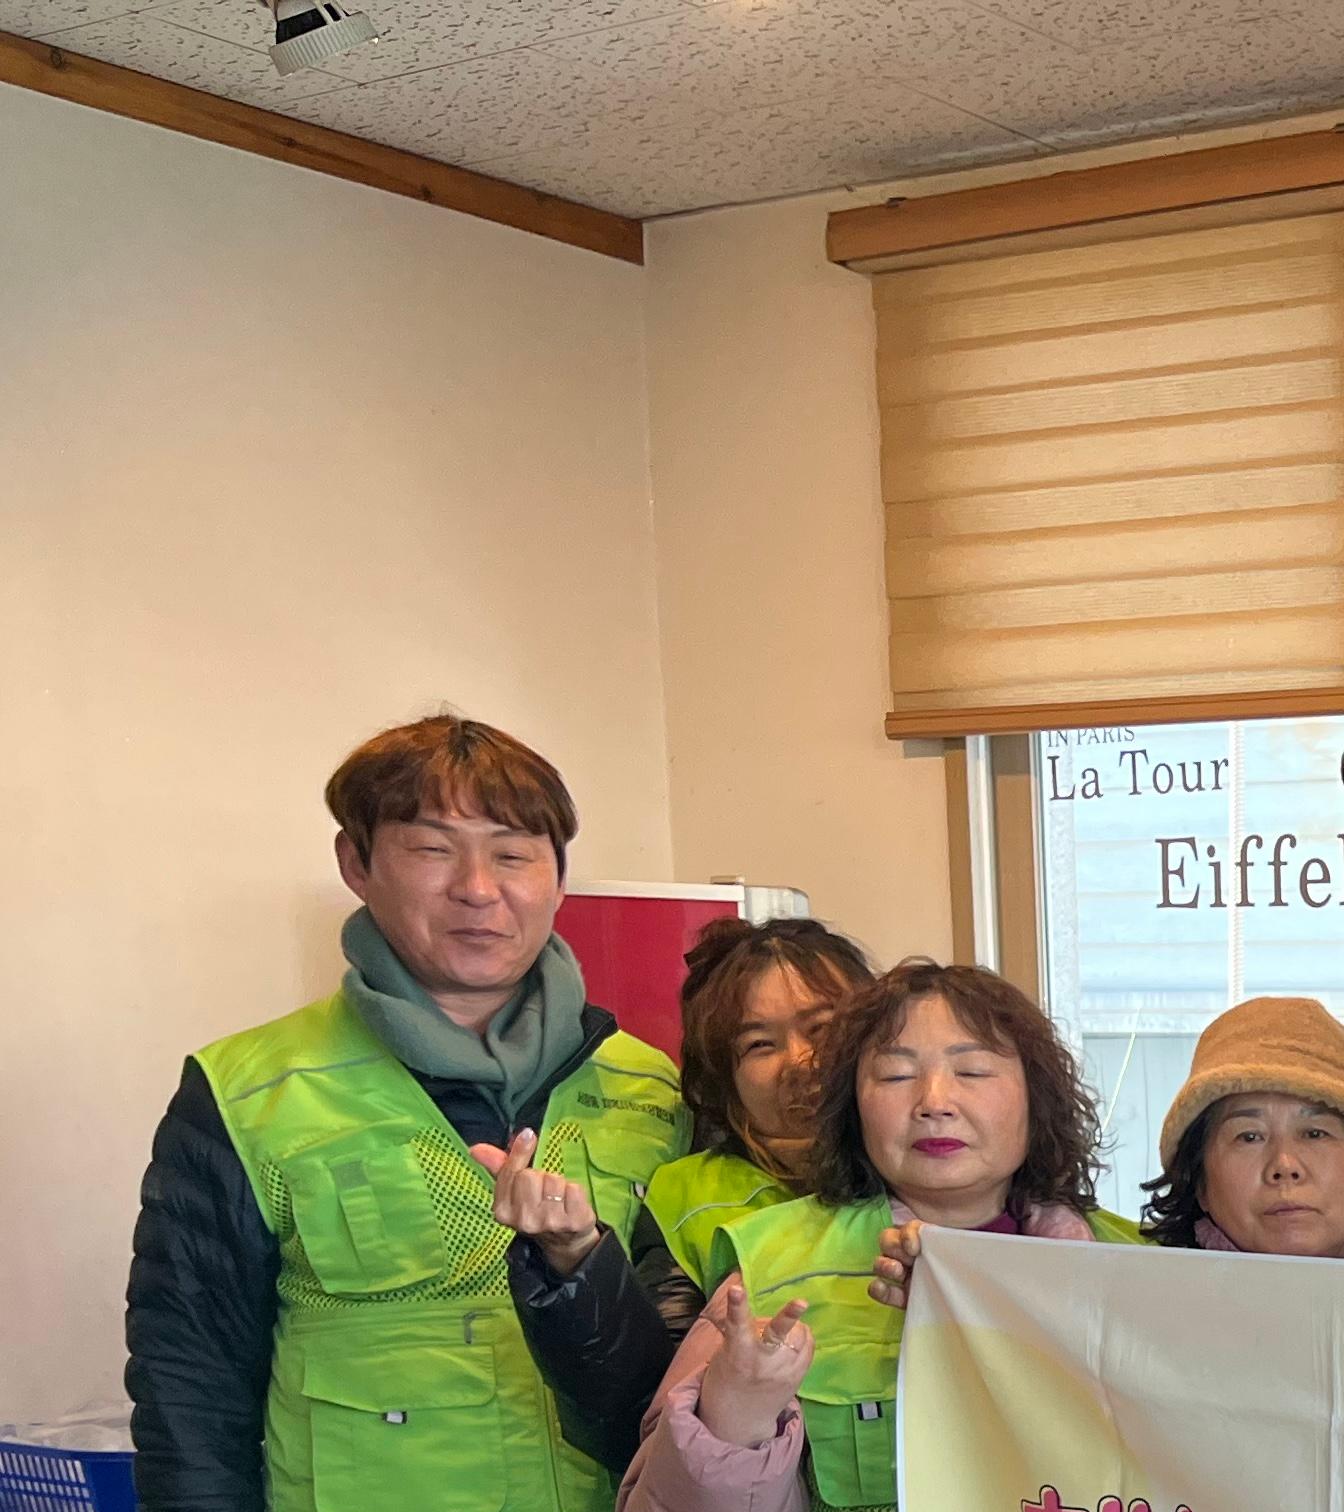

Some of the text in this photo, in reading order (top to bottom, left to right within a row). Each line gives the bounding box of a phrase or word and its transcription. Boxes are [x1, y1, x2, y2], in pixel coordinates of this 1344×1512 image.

[1047, 726, 1135, 747] IN PARIS
[1047, 749, 1229, 801] La Tour
